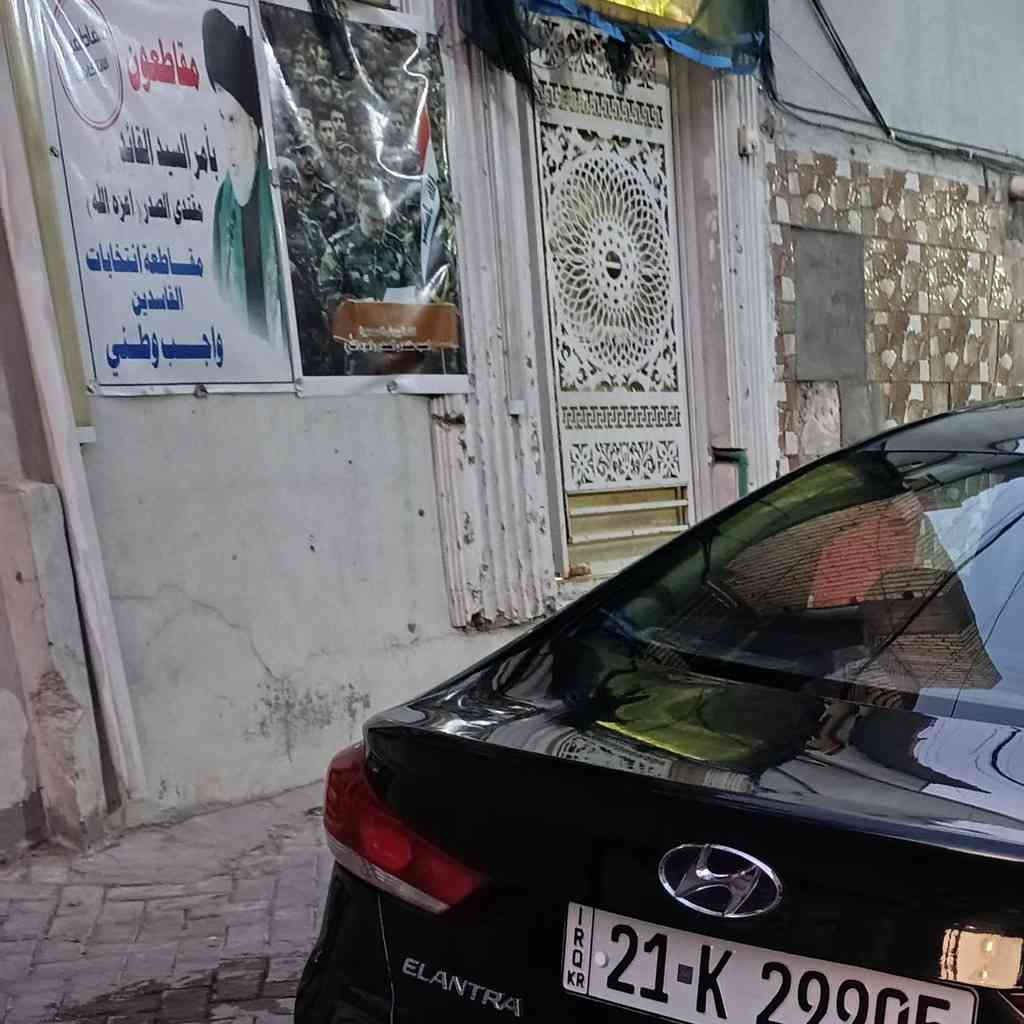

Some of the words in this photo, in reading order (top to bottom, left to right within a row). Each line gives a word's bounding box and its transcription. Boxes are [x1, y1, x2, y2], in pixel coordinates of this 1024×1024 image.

[128, 38, 200, 92] مقاطعون
[120, 121, 154, 165] القائد
[156, 132, 191, 176] السيد
[144, 192, 171, 224] الصدر
[86, 242, 143, 280] انتخابات
[132, 285, 184, 316] الفاسدين
[106, 323, 160, 377] وطني
[161, 325, 224, 368] واجب
[402, 957, 520, 1017] ELANTRA
